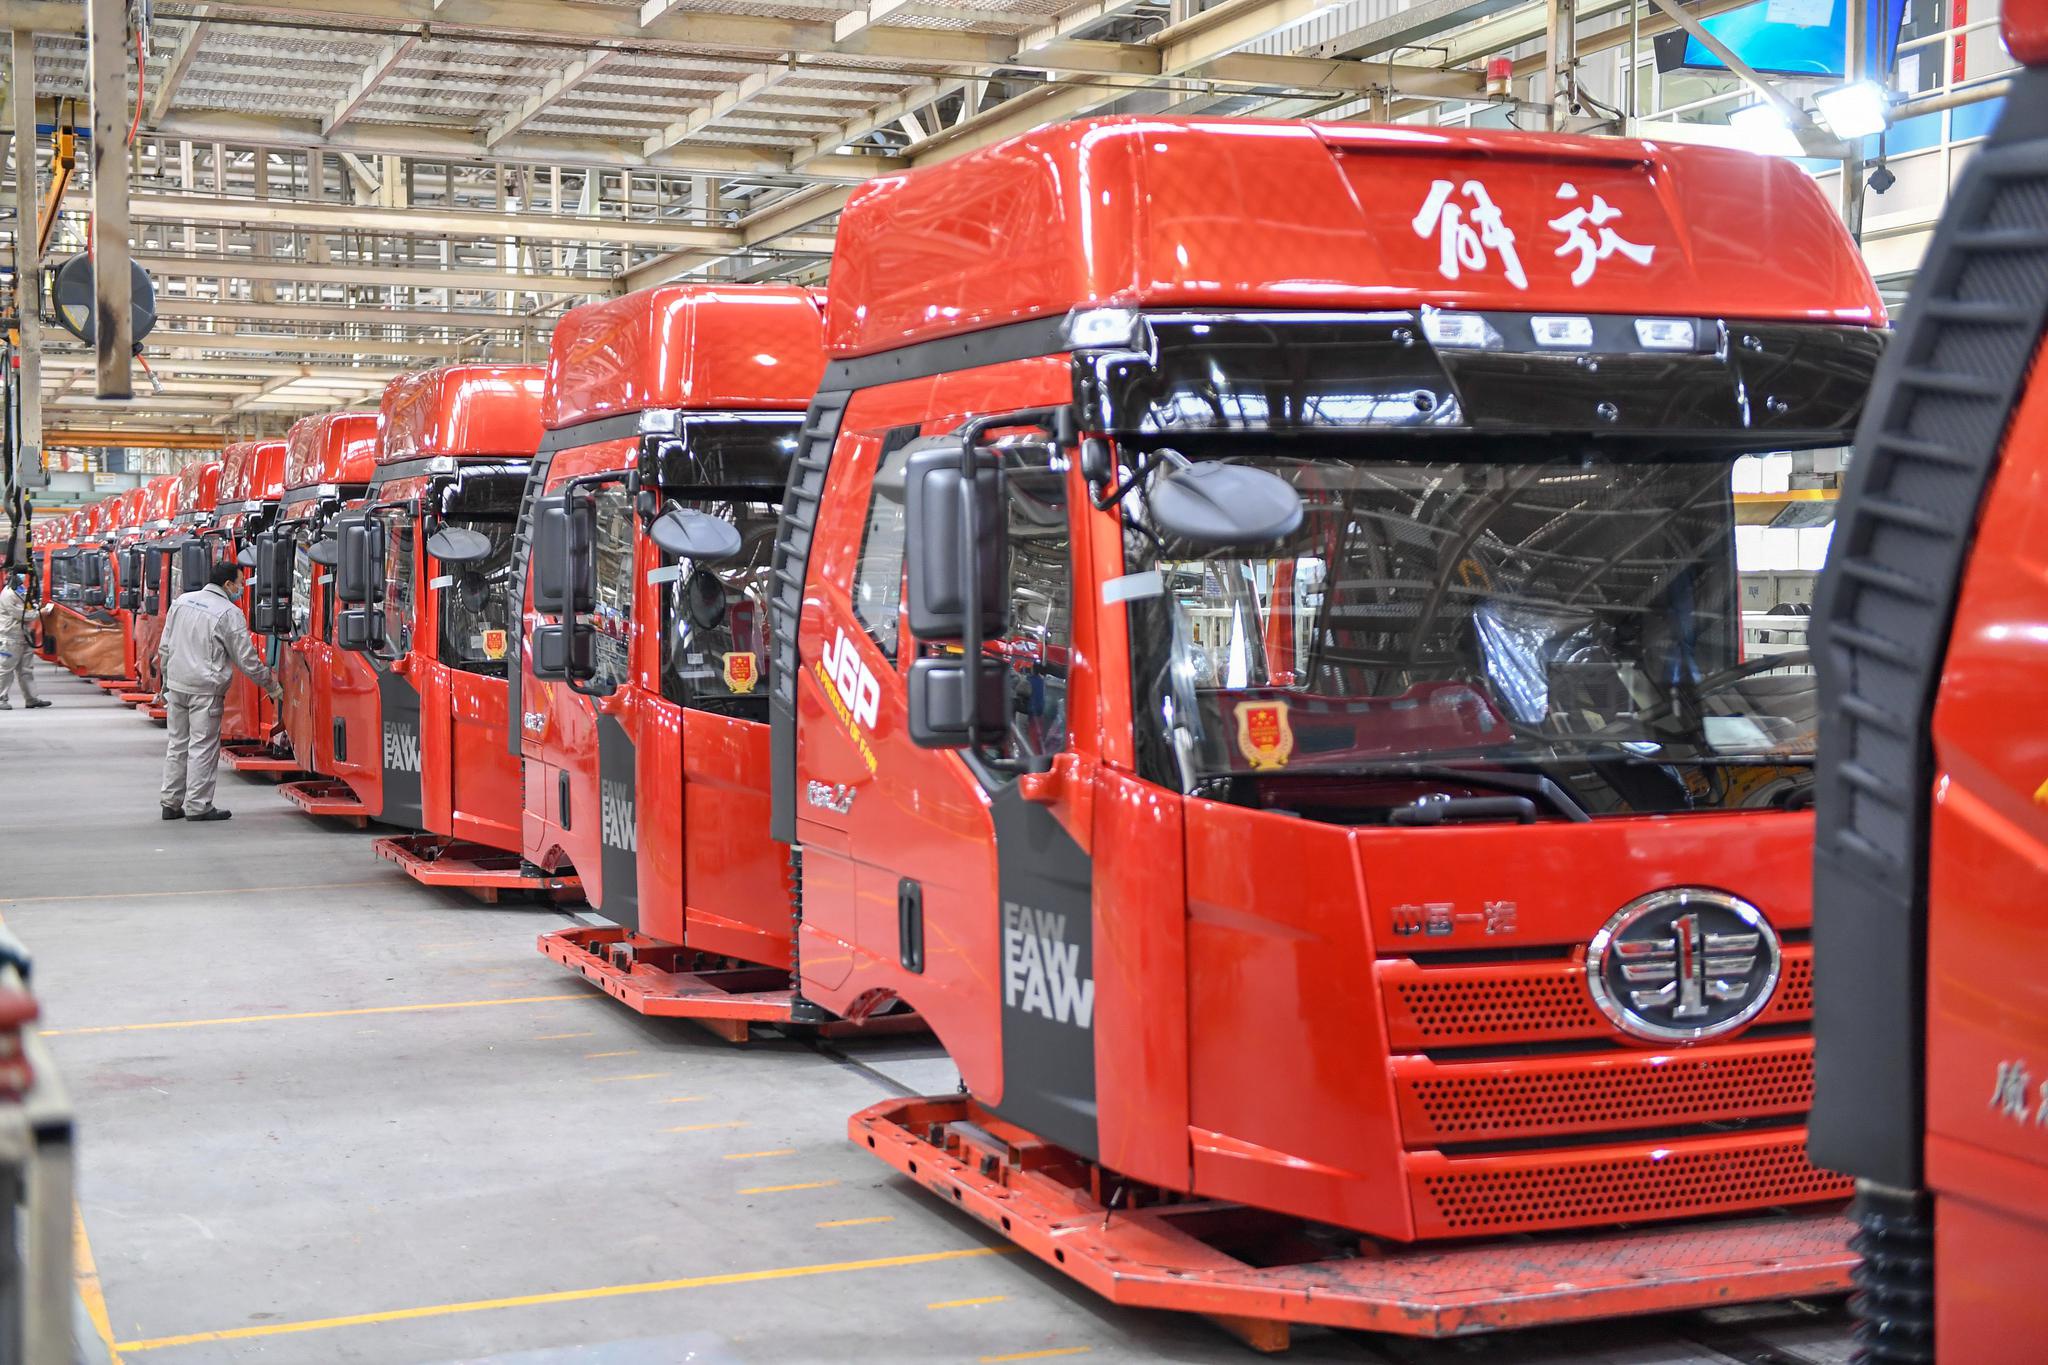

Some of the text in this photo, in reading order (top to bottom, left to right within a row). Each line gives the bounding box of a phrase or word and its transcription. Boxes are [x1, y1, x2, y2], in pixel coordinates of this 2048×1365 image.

[1412, 179, 1656, 289] 解放
[822, 625, 881, 730] J6P
[384, 748, 421, 772] FAW
[602, 815, 637, 852] FAW
[1391, 901, 1517, 936] 中国一汽
[1006, 963, 1095, 1029] FAW
